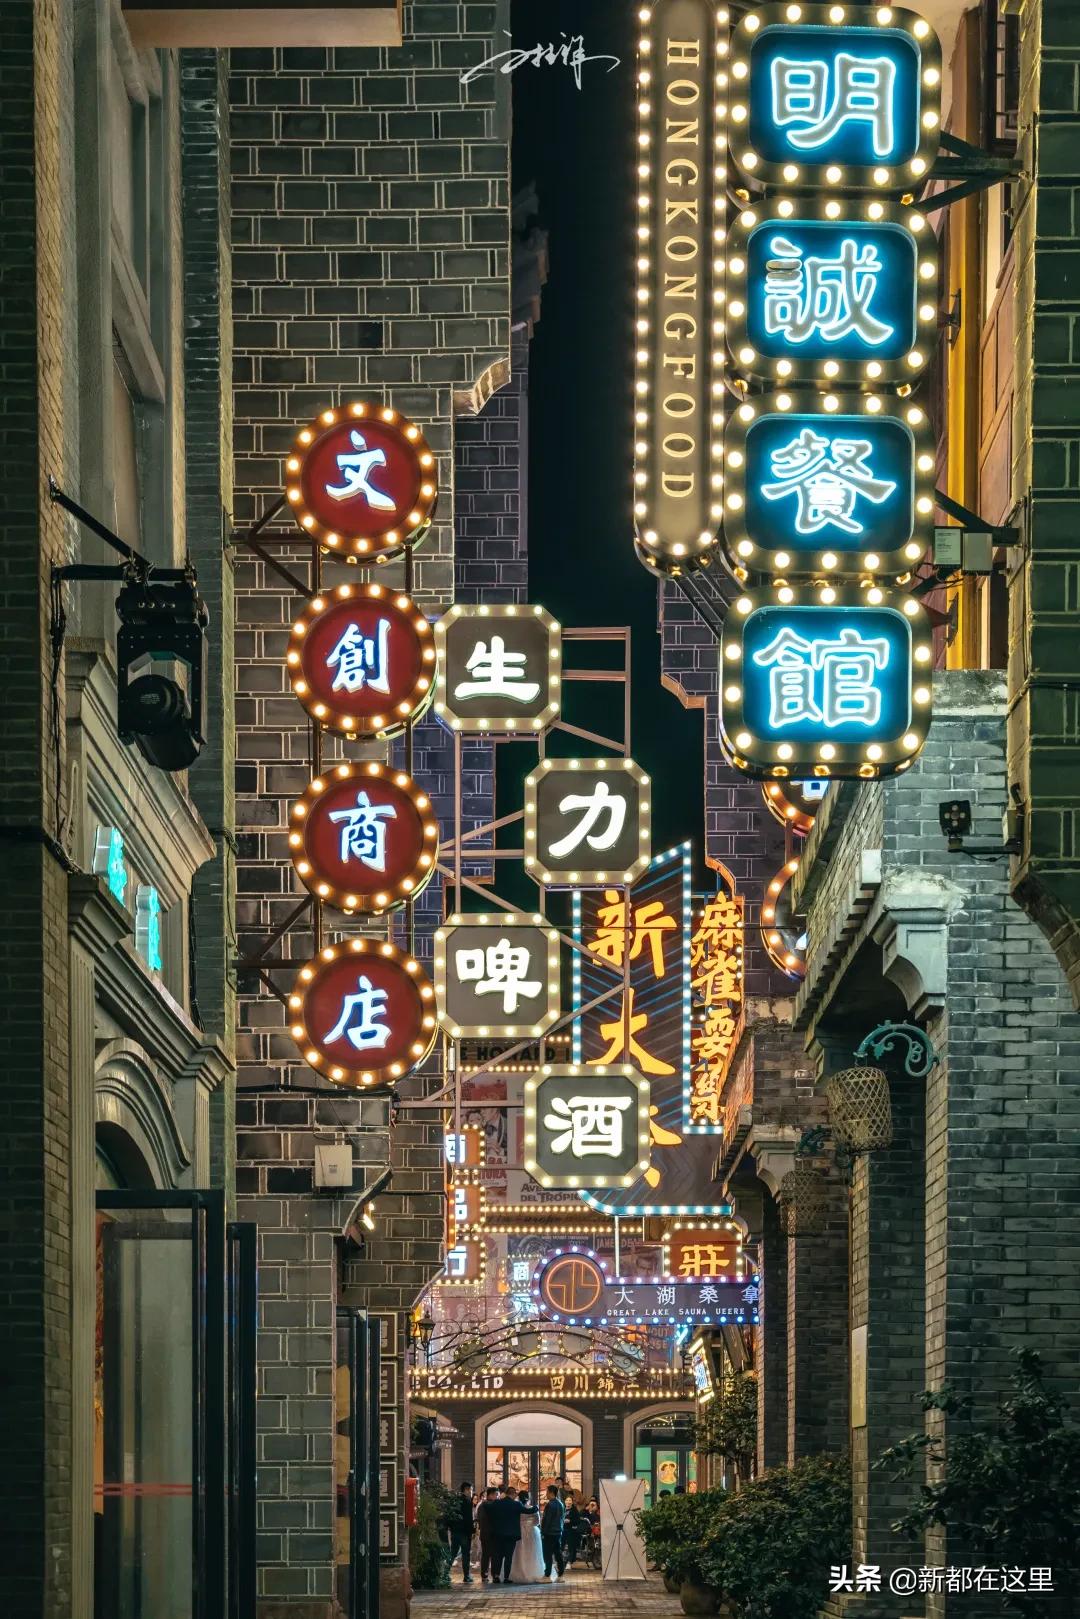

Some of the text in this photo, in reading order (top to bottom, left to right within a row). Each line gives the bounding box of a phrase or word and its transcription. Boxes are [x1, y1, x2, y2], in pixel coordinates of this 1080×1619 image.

[753, 52, 897, 729] 明誠餐館
[323, 428, 398, 1053] 文創商店
[453, 635, 634, 1159] 生力啤酒
[585, 889, 685, 1189] 新大
[471, 1375, 504, 1389] LTD
[613, 1285, 759, 1306] 大湖桑拿
[645, 1308, 669, 1316] LAKE
